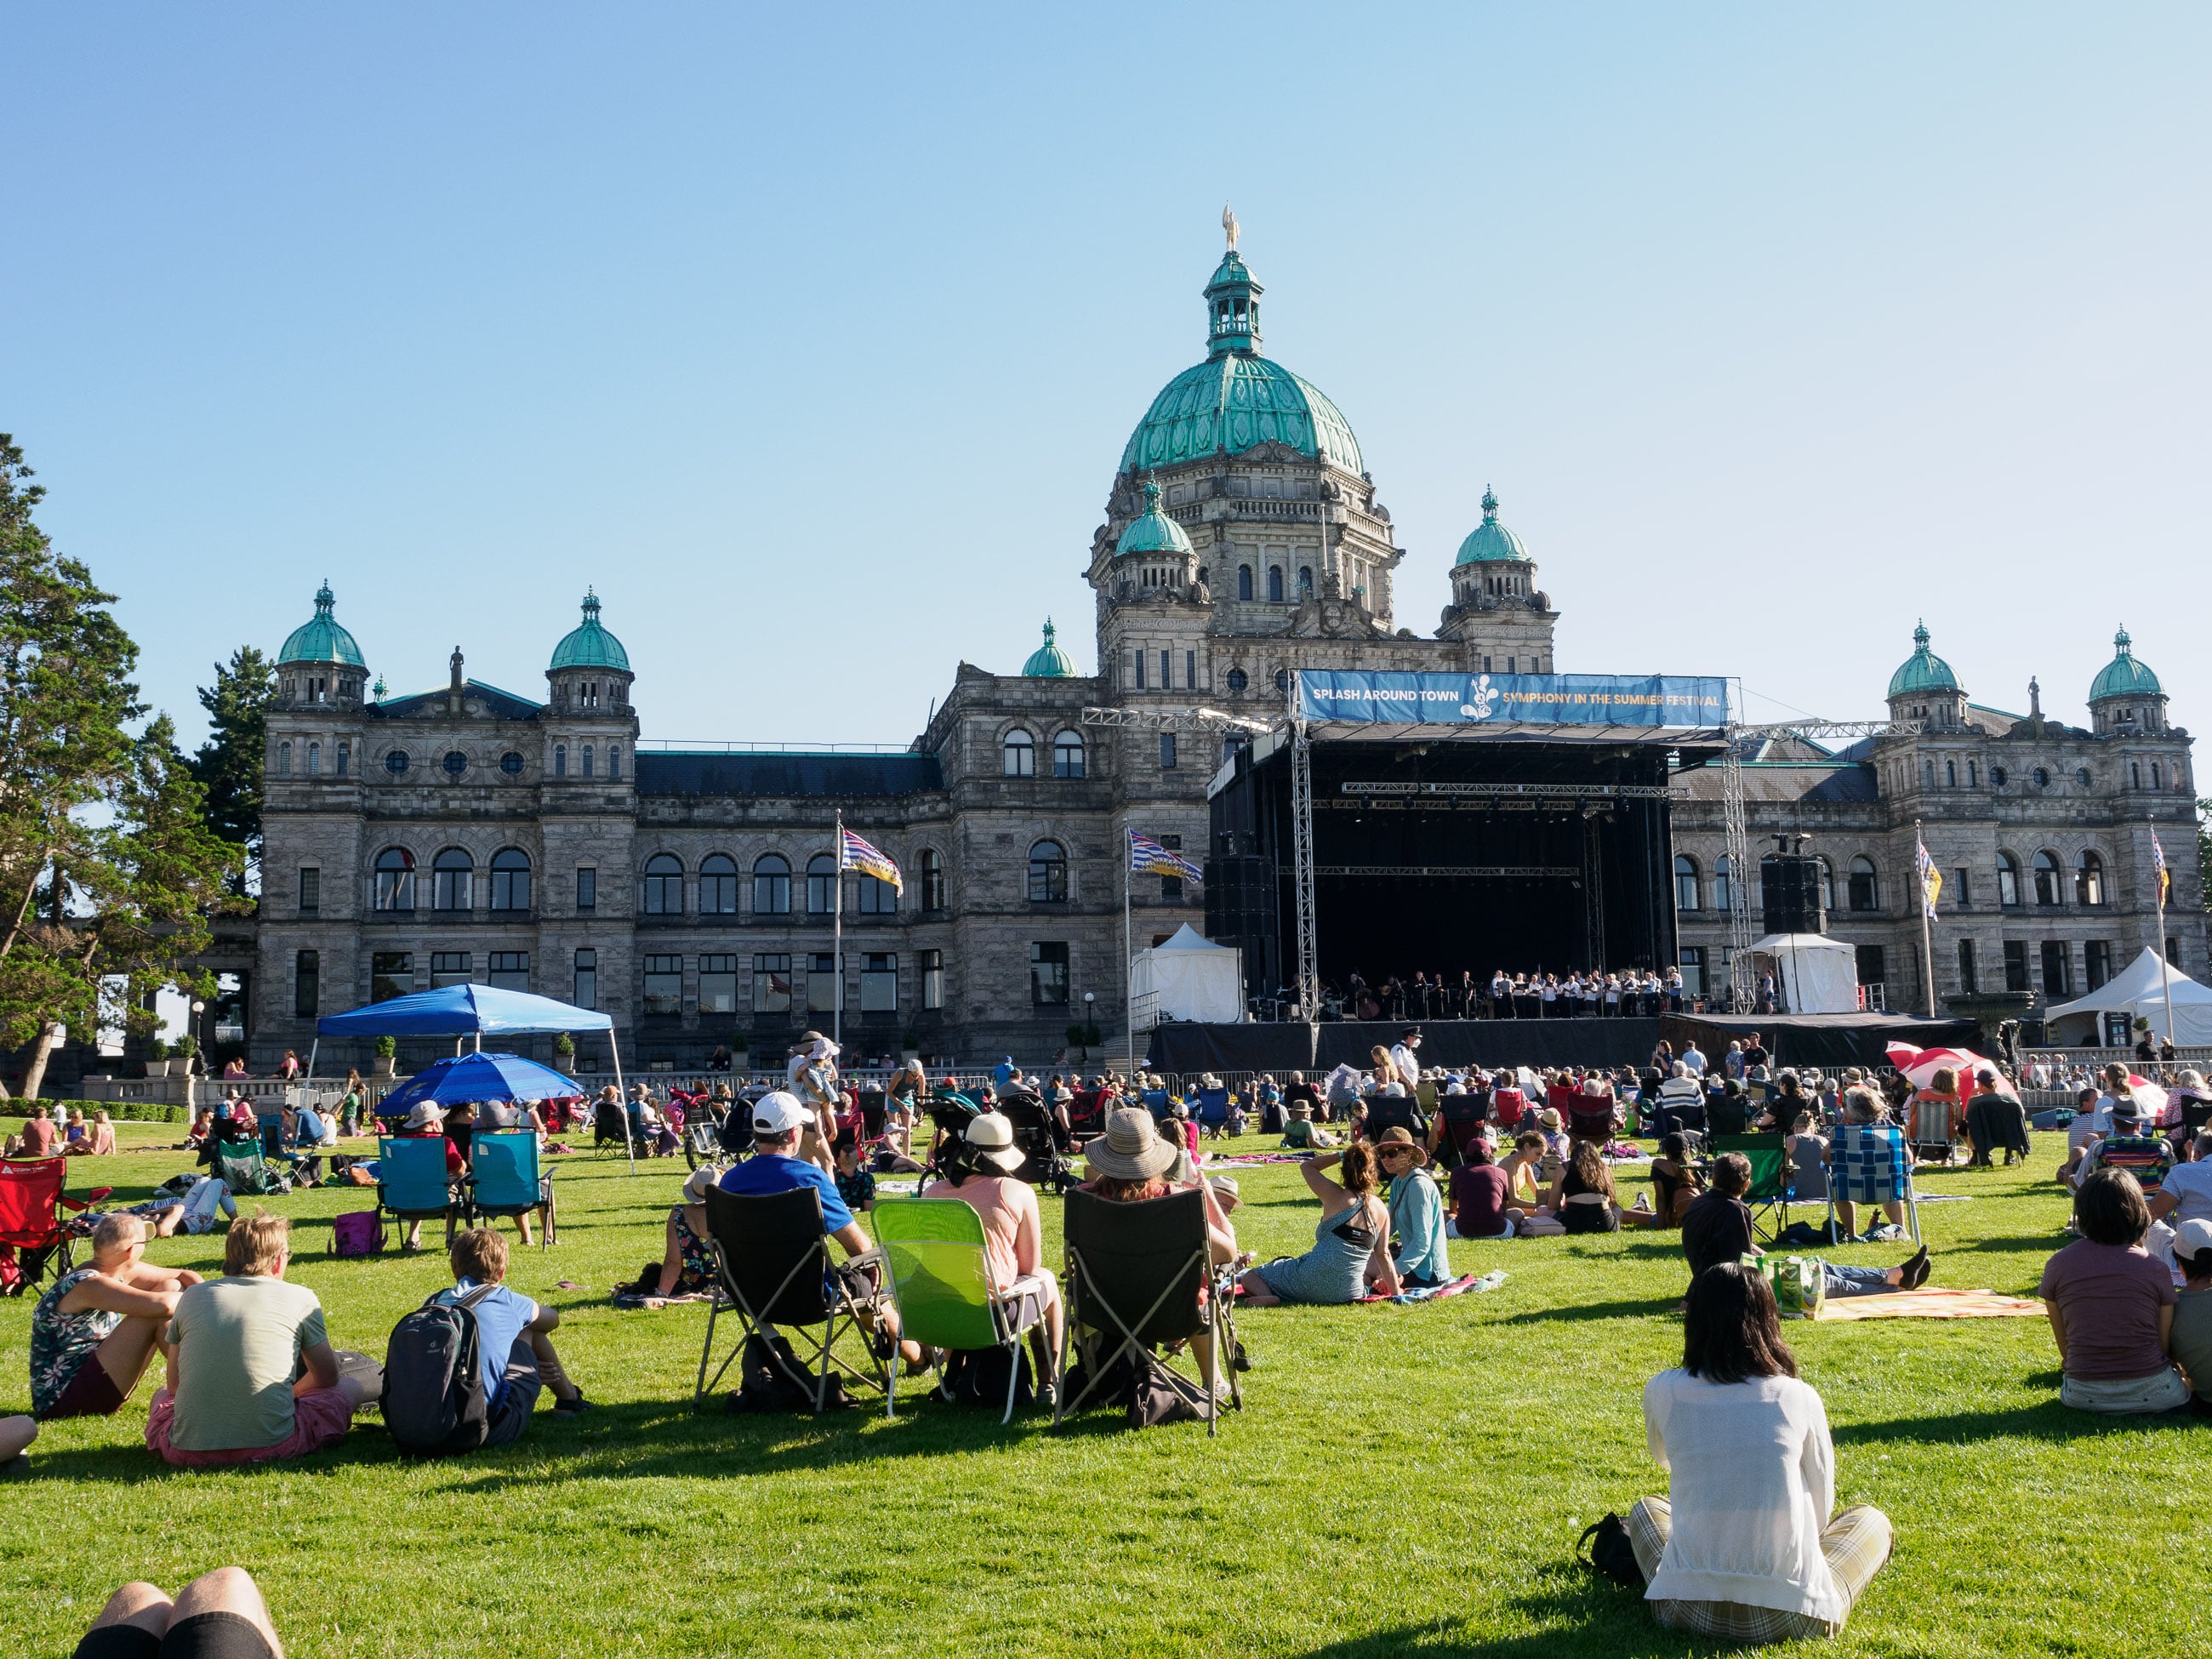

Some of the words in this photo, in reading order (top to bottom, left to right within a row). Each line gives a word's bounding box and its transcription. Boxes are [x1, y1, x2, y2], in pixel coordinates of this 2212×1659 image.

[1313, 688, 1360, 700] SPLASH
[1363, 689, 1417, 701] AROUND
[1419, 691, 1459, 702] TOWN
[1502, 692, 1571, 704] SYMPHONY
[1574, 693, 1587, 704] IN
[1589, 693, 1611, 704] THE
[1613, 693, 1663, 705] SUMMER
[1666, 695, 1719, 706] FESTIVAL
